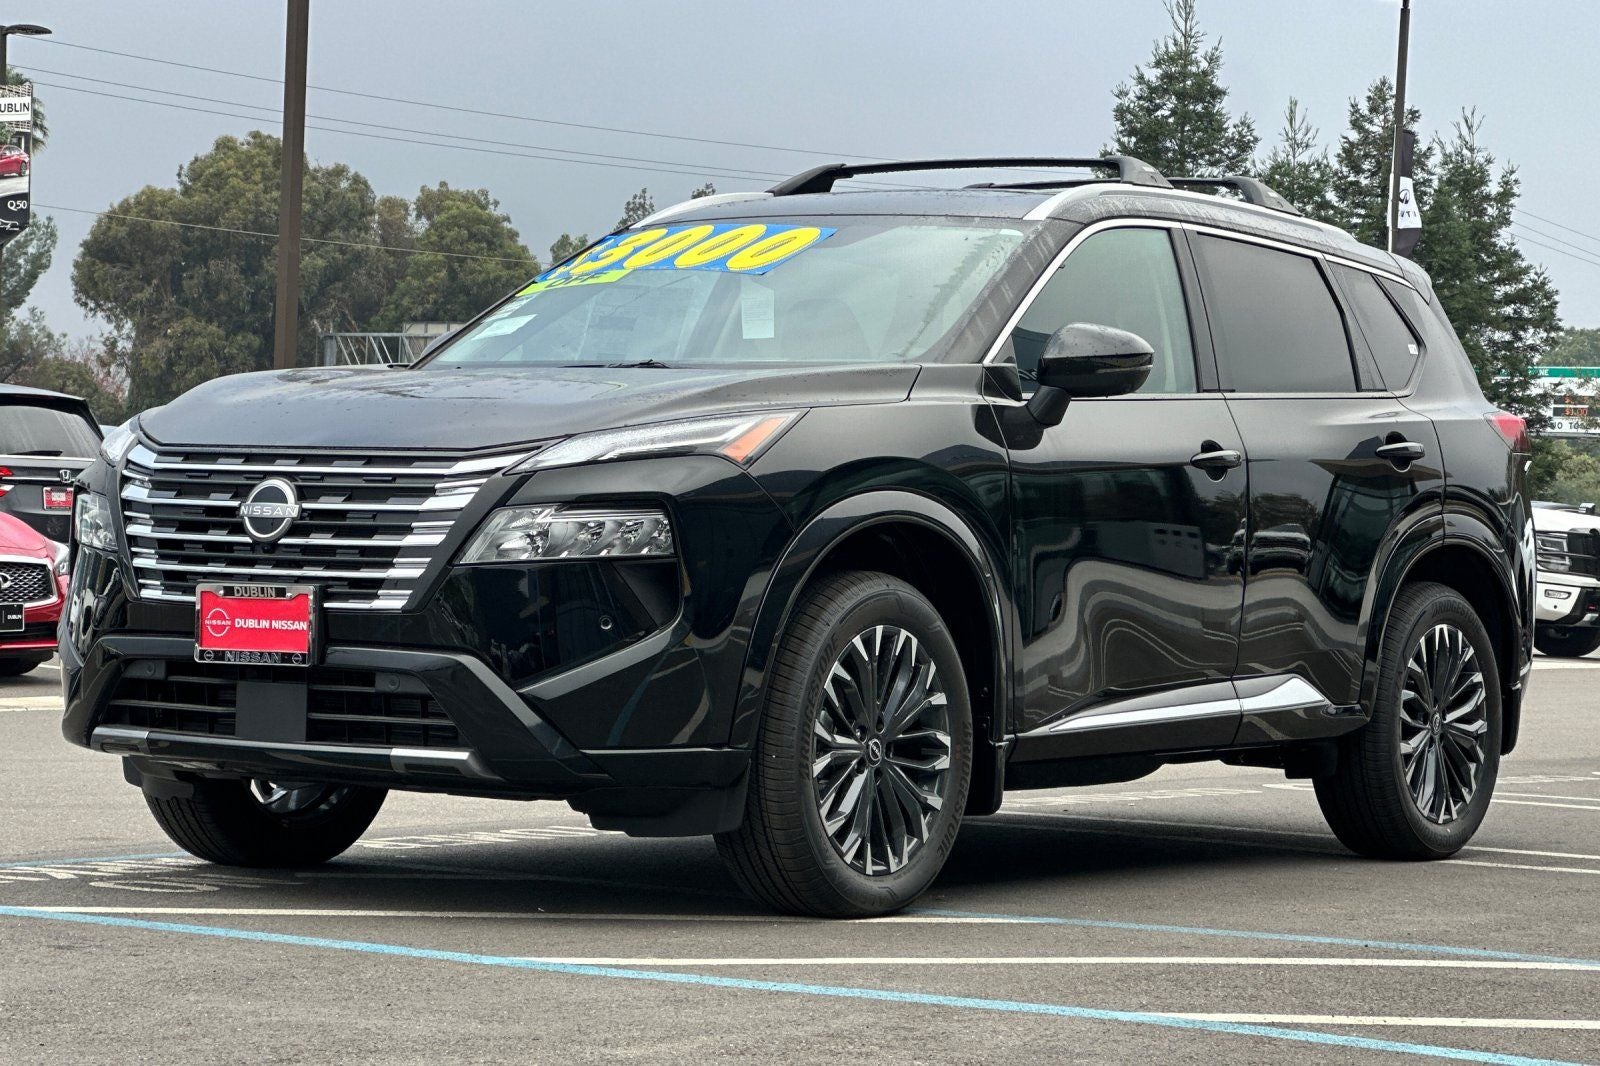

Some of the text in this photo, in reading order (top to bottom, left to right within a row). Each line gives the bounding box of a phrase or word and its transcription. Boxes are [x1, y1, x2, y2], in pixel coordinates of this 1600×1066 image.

[7, 200, 28, 211] Q50
[240, 505, 299, 516] NISSAN
[233, 586, 276, 598] DUBLIN
[234, 618, 307, 631] DUBLIN NISSAN
[224, 651, 282, 664] NISSAN
